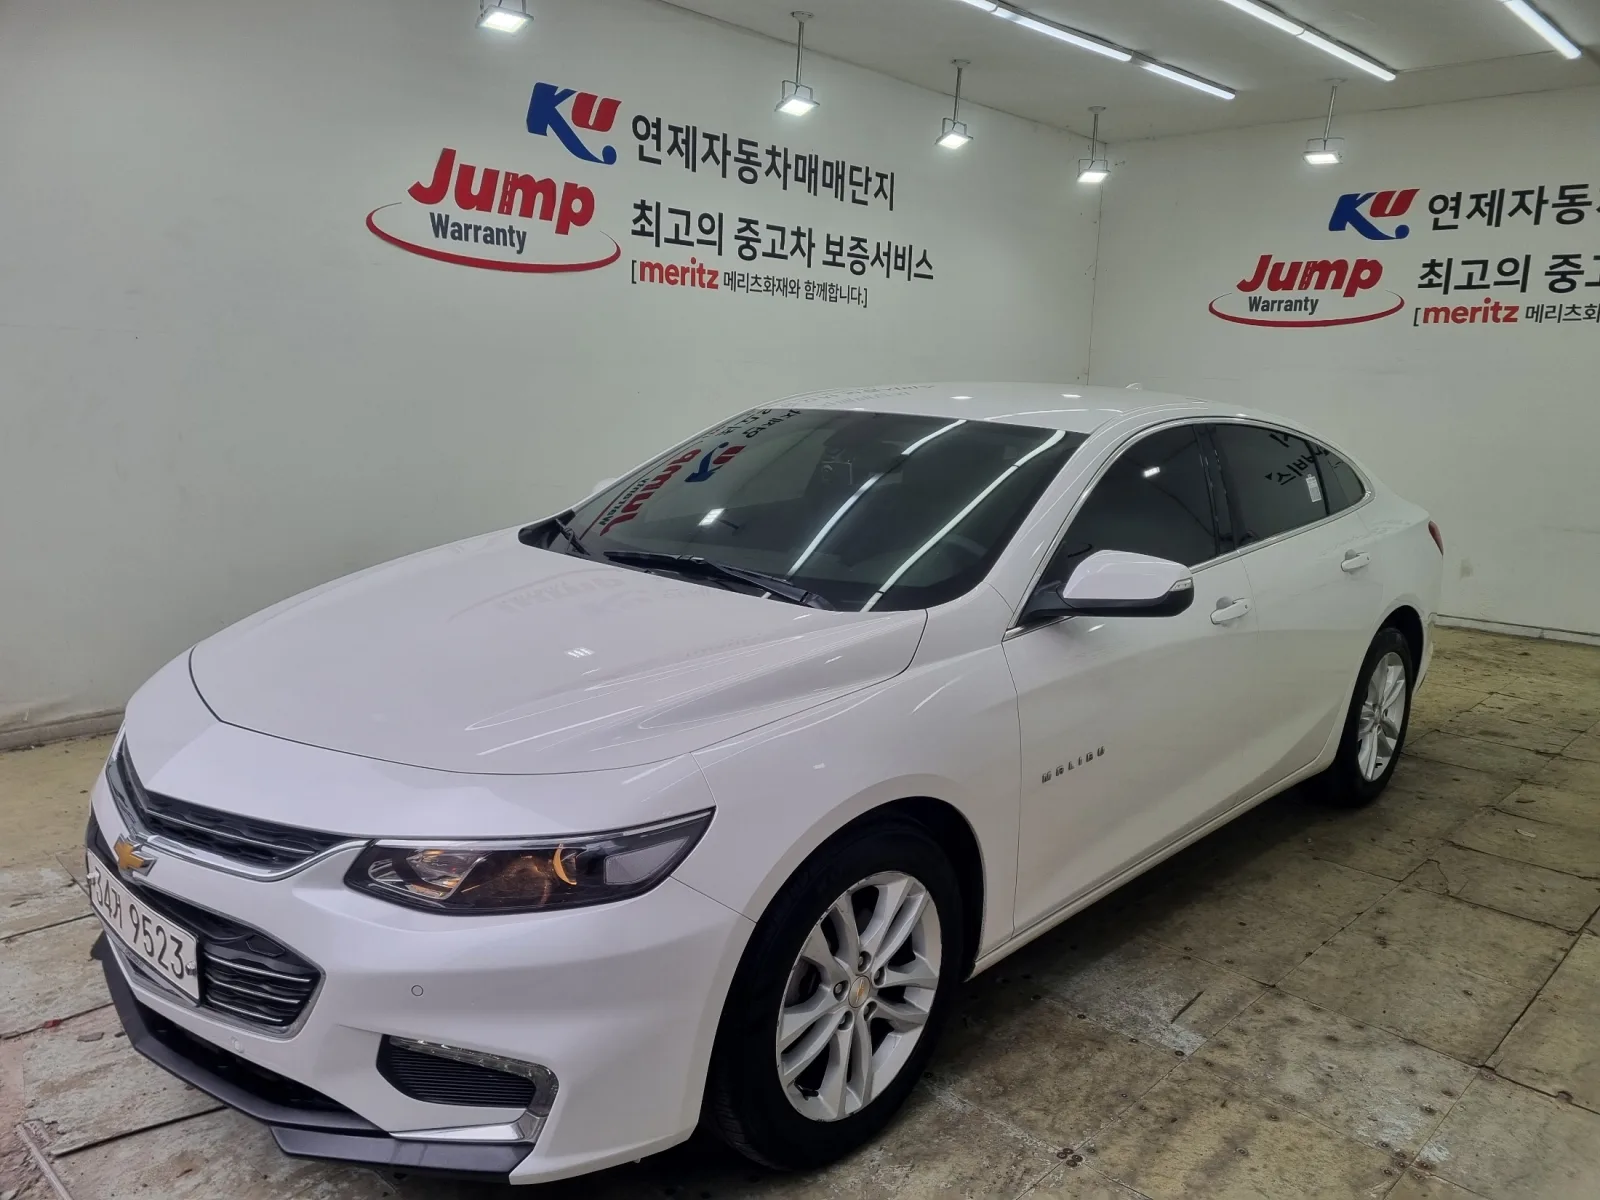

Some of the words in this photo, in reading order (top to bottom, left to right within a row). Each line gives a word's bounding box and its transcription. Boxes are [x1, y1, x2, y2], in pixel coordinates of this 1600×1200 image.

[631, 114, 895, 212] 연제자동차매매단지
[407, 147, 595, 235] Jump
[1427, 183, 1600, 231] 연제자동
[429, 212, 527, 255] Warranty
[631, 199, 724, 256] 최고의
[734, 217, 816, 268] 중고차
[822, 233, 934, 281] 보증서비스
[723, 271, 801, 299] 메리츠화재와
[1236, 254, 1383, 298] Jump
[1417, 254, 1532, 293] 최고의
[1248, 296, 1319, 316] Warranty
[1041, 745, 1105, 784] MALIBU
[129, 903, 185, 980] 9523
